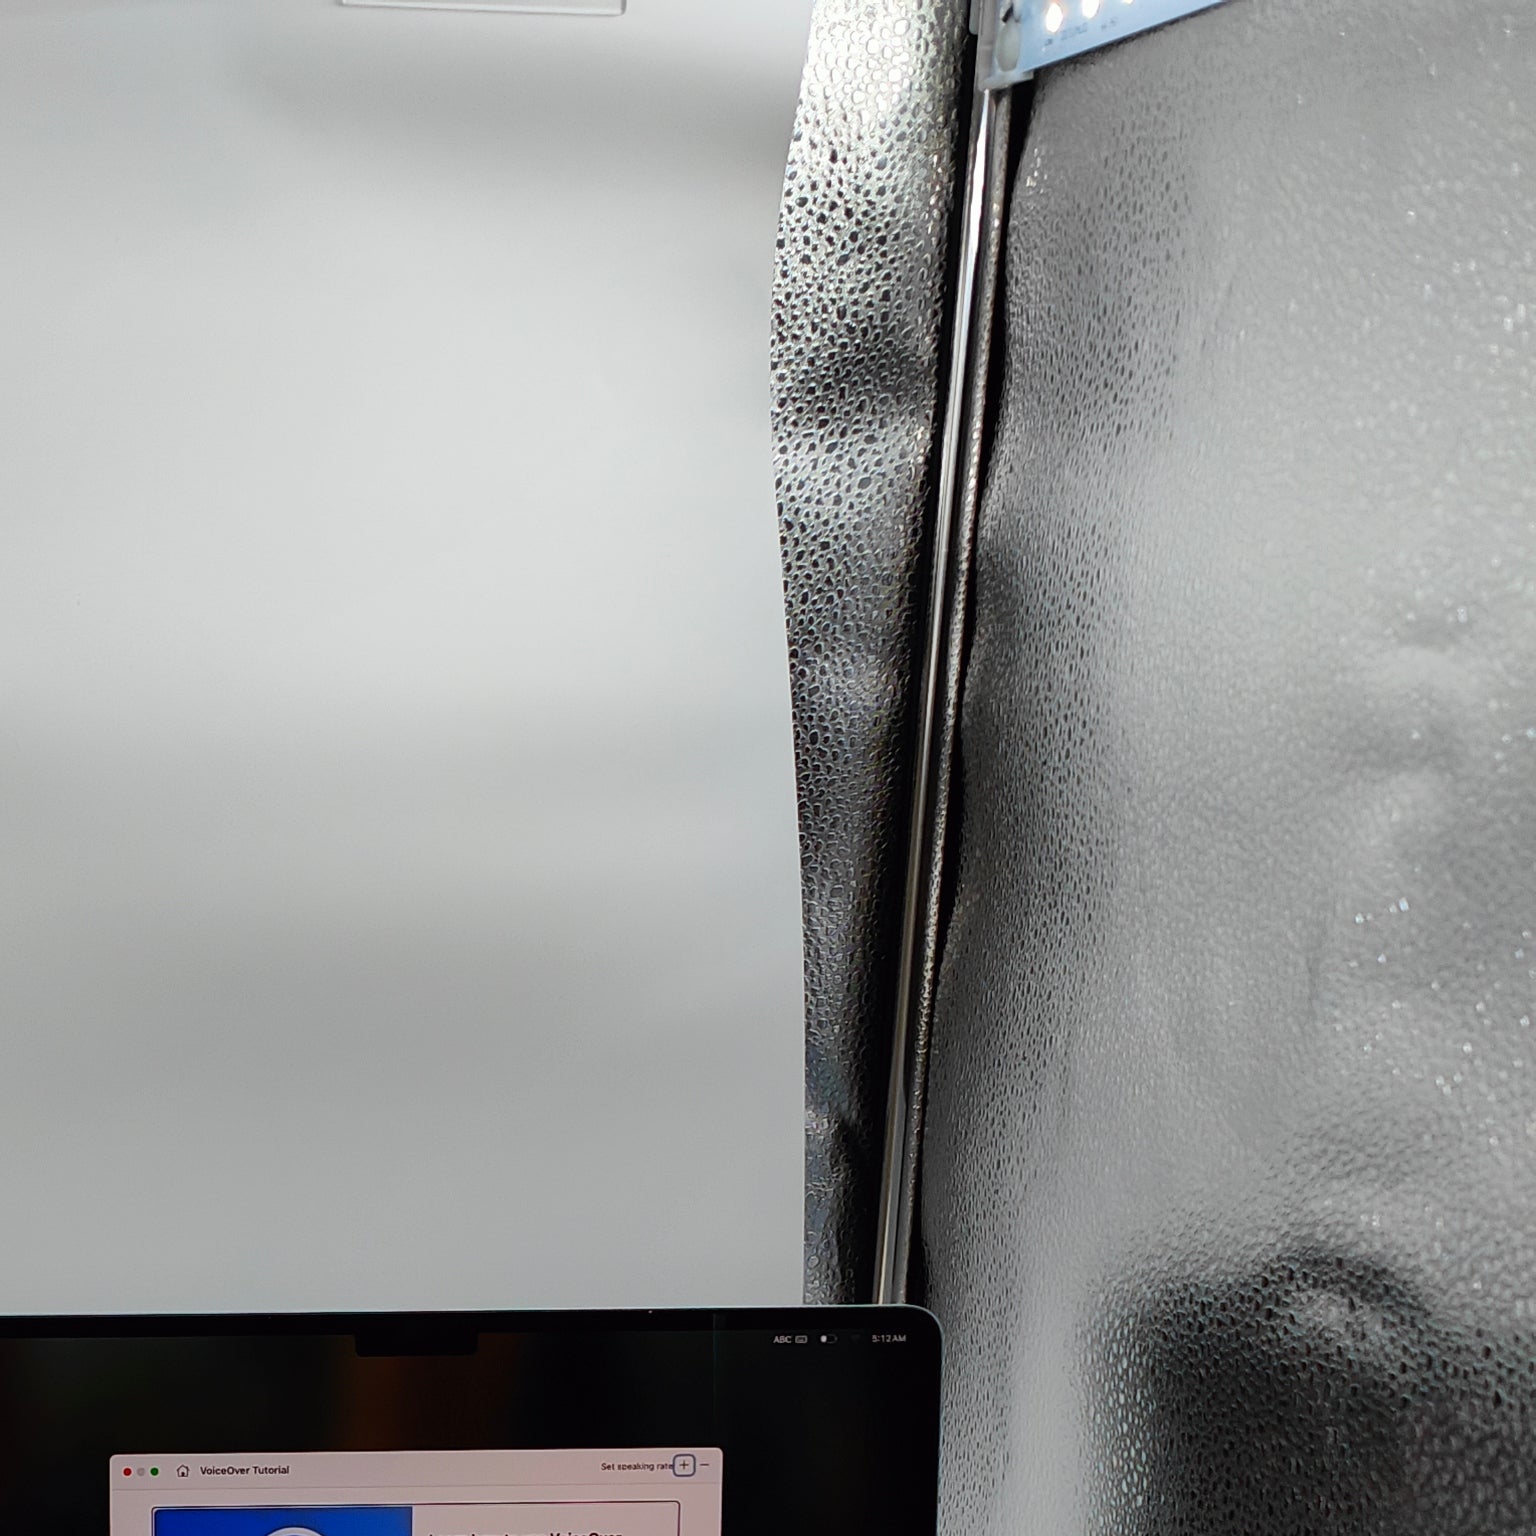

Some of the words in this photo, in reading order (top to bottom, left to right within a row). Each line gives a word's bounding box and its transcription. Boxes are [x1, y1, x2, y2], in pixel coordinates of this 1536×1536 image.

[773, 1335, 792, 1344] ABC
[199, 1465, 250, 1475] VoiceOver
[252, 1465, 289, 1474] Tutorial
[601, 1462, 615, 1470] Set
[617, 1462, 654, 1471] speaking
[656, 1462, 673, 1470] rate
